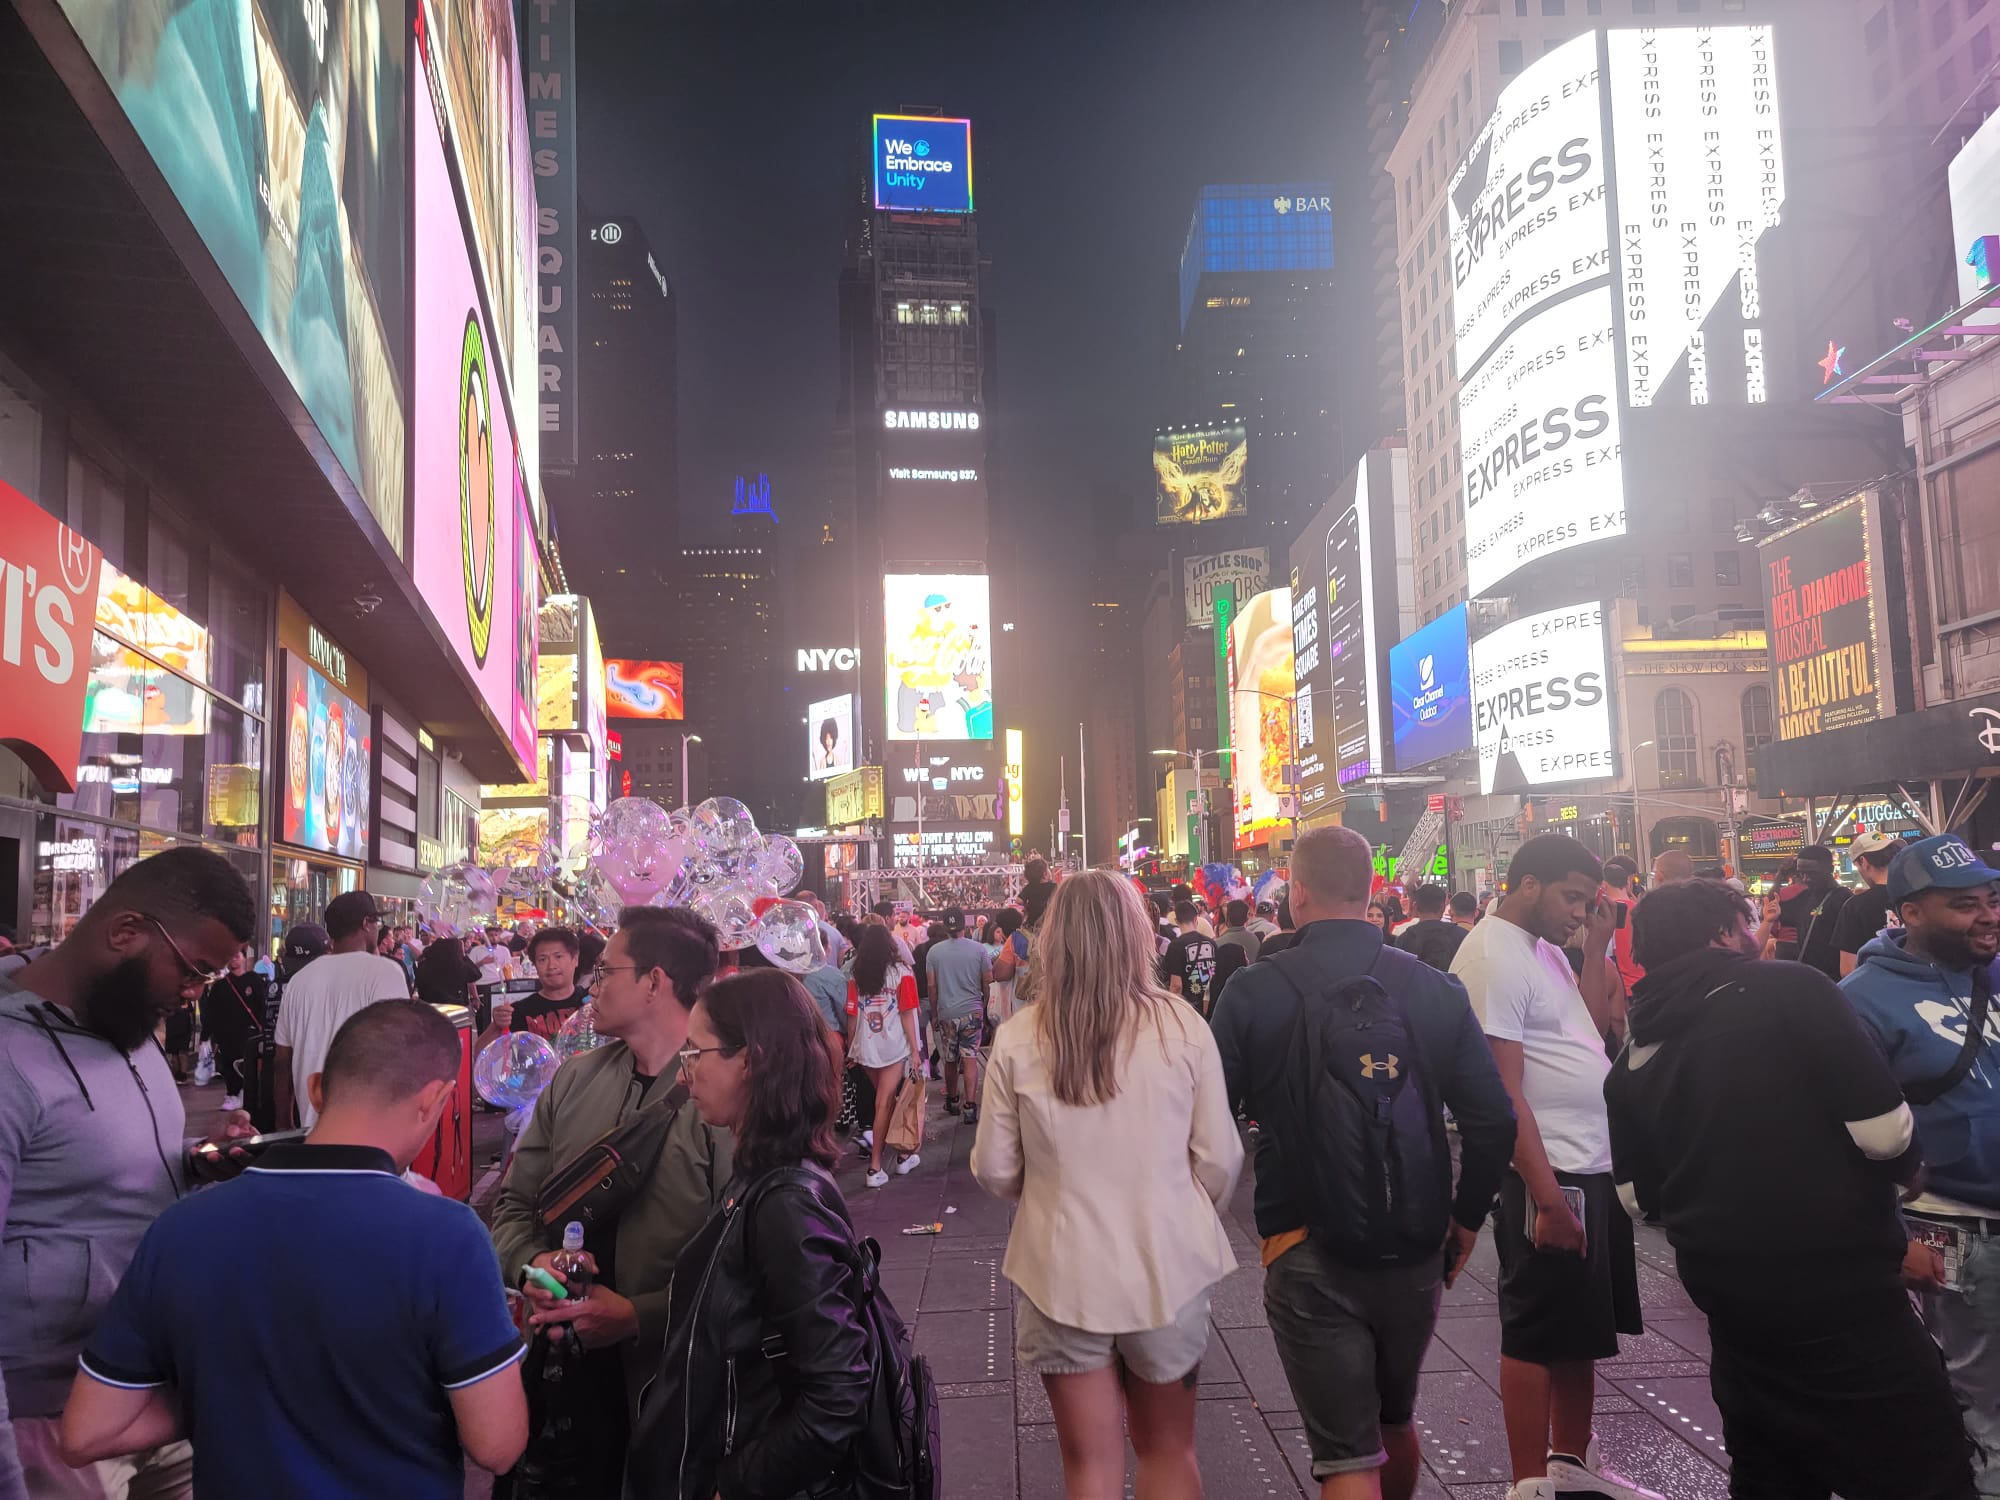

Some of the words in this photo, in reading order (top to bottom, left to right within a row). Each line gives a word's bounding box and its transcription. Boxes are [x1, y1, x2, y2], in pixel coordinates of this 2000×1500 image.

[529, 0, 561, 177] TIMES
[1494, 95, 1550, 154] EXPRESS
[885, 138, 912, 155] We
[885, 155, 953, 172] Embrace
[886, 171, 926, 190] Unity
[1647, 133, 1668, 229] EXPRESS
[1704, 131, 1725, 227] EXPRESS
[1455, 137, 1592, 290] EXPRESS
[1499, 205, 1558, 260] EXPRESS
[1625, 224, 1646, 321] EXPRESS
[1681, 222, 1702, 321] EXPRESS
[1477, 269, 1511, 318] EXPRESS
[1502, 269, 1561, 318] EXPRESS
[538, 207, 564, 432] SQUARE
[1507, 345, 1566, 390] EXPRESS
[885, 410, 979, 430] SAMSUNG
[1485, 402, 1517, 444] EXPRESS
[1172, 442, 1200, 463] Harry
[1199, 438, 1229, 461] Potter
[1467, 394, 1610, 509] EXPRESS
[889, 468, 911, 479] Visit
[911, 468, 958, 482] Samsung
[1513, 458, 1573, 498] EXPRESS
[1490, 511, 1524, 547] EXPRESS
[1517, 522, 1577, 558] EXPRESS
[1192, 555, 1231, 580] LITTLE
[1233, 554, 1263, 572] SHOP
[1769, 556, 1792, 595] THE
[1193, 575, 1262, 617] HOORS
[1293, 595, 1305, 622] TAKE
[1304, 586, 1317, 612] OVER
[1772, 585, 1801, 630] NEIL
[1801, 560, 1869, 619] DIAMOND
[1293, 608, 1318, 654] TIMES
[1774, 616, 1828, 665] MUSICAL
[309, 624, 348, 687] INVICTA
[1295, 642, 1319, 681] SQUARE
[1497, 650, 1549, 678] EXPRESS
[1669, 663, 1703, 673] SHOW
[1710, 661, 1746, 672] FOLKS
[1413, 696, 1425, 710] Clear
[1425, 684, 1444, 704] Channel
[1777, 667, 1789, 716] A
[1789, 641, 1873, 713] BEAUTIFUL
[1420, 704, 1438, 721] Outdoor
[1477, 672, 1603, 732] EXPRESS
[1780, 708, 1822, 742] NOISE
[903, 768, 929, 782] WE
[950, 766, 984, 781] NYC
[921, 832, 943, 844] THAT
[954, 831, 972, 843] YOU
[1752, 828, 1801, 842] ELECTRONICS
[1754, 841, 1775, 849] CAMERA
